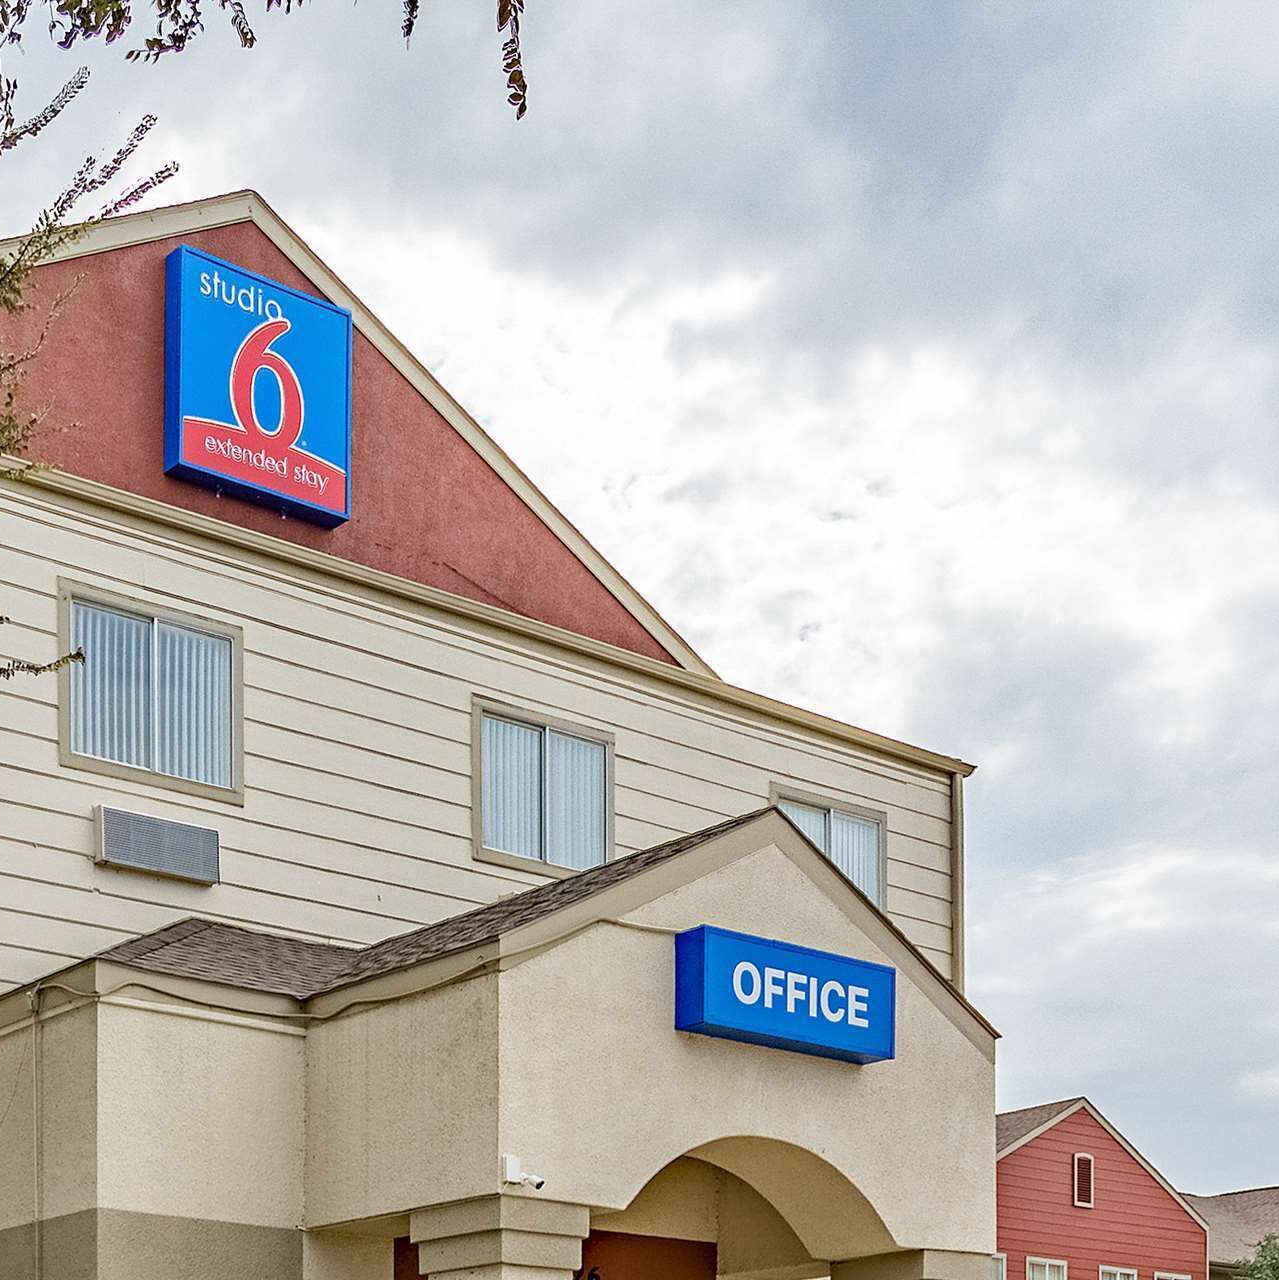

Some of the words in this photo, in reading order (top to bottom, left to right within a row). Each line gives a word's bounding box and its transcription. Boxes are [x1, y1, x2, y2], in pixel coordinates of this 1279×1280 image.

[200, 271, 282, 321] studio
[230, 318, 304, 445] 6
[204, 435, 288, 477] extended
[293, 464, 328, 495] stay
[732, 961, 869, 1028] OFFICE
